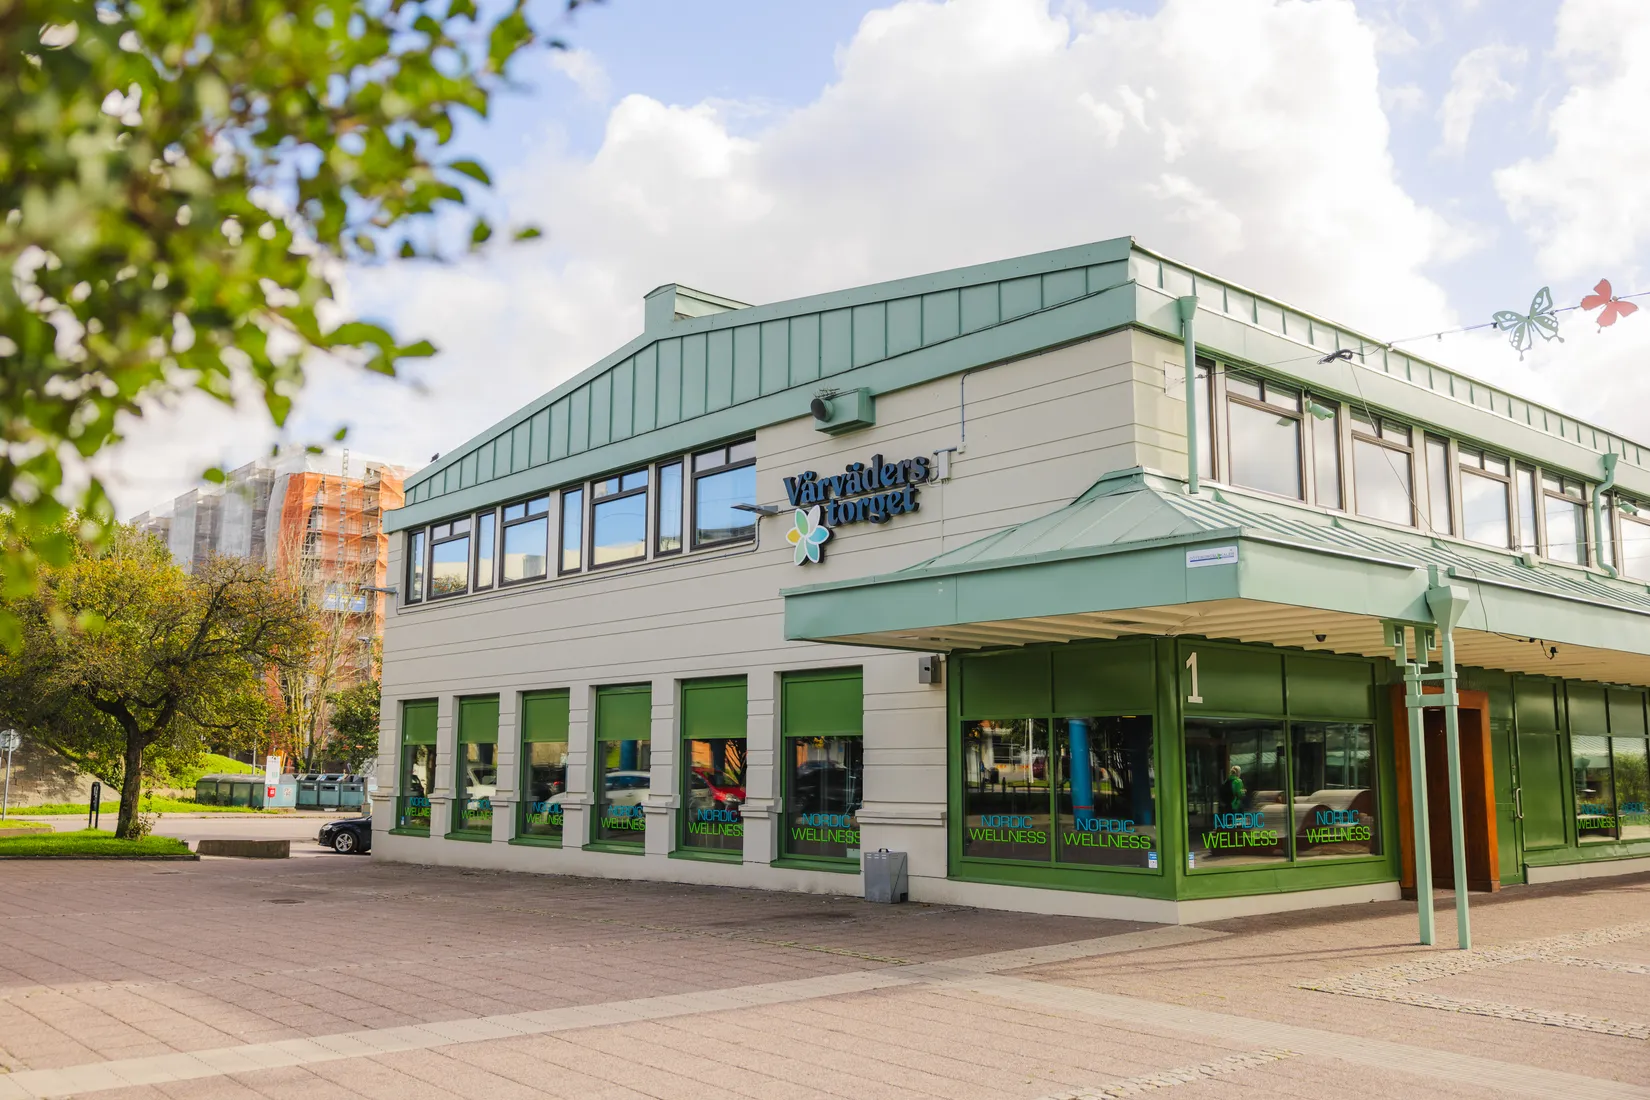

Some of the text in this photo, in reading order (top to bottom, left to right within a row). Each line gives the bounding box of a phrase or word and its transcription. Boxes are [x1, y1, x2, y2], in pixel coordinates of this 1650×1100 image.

[783, 454, 930, 506] Vårväders
[826, 483, 921, 526] torget
[1186, 652, 1203, 704] 1
[607, 804, 643, 818] NORDIC
[697, 808, 738, 823] NORDIC
[1316, 809, 1360, 826] NORDIC
[601, 817, 645, 831] WELLNES
[801, 813, 851, 828] NORDIC
[981, 815, 1033, 829] NORDIC
[1076, 818, 1135, 833] NORDIC
[1214, 811, 1265, 829] NORDIC
[1577, 816, 1616, 829] WELLNESS
[791, 828, 860, 845] WELLNESS
[969, 828, 1046, 844] WELLNESS
[1064, 833, 1151, 850] WELLNESS
[1202, 830, 1278, 849] WELLNESS
[1306, 826, 1371, 843] WELLNESS
